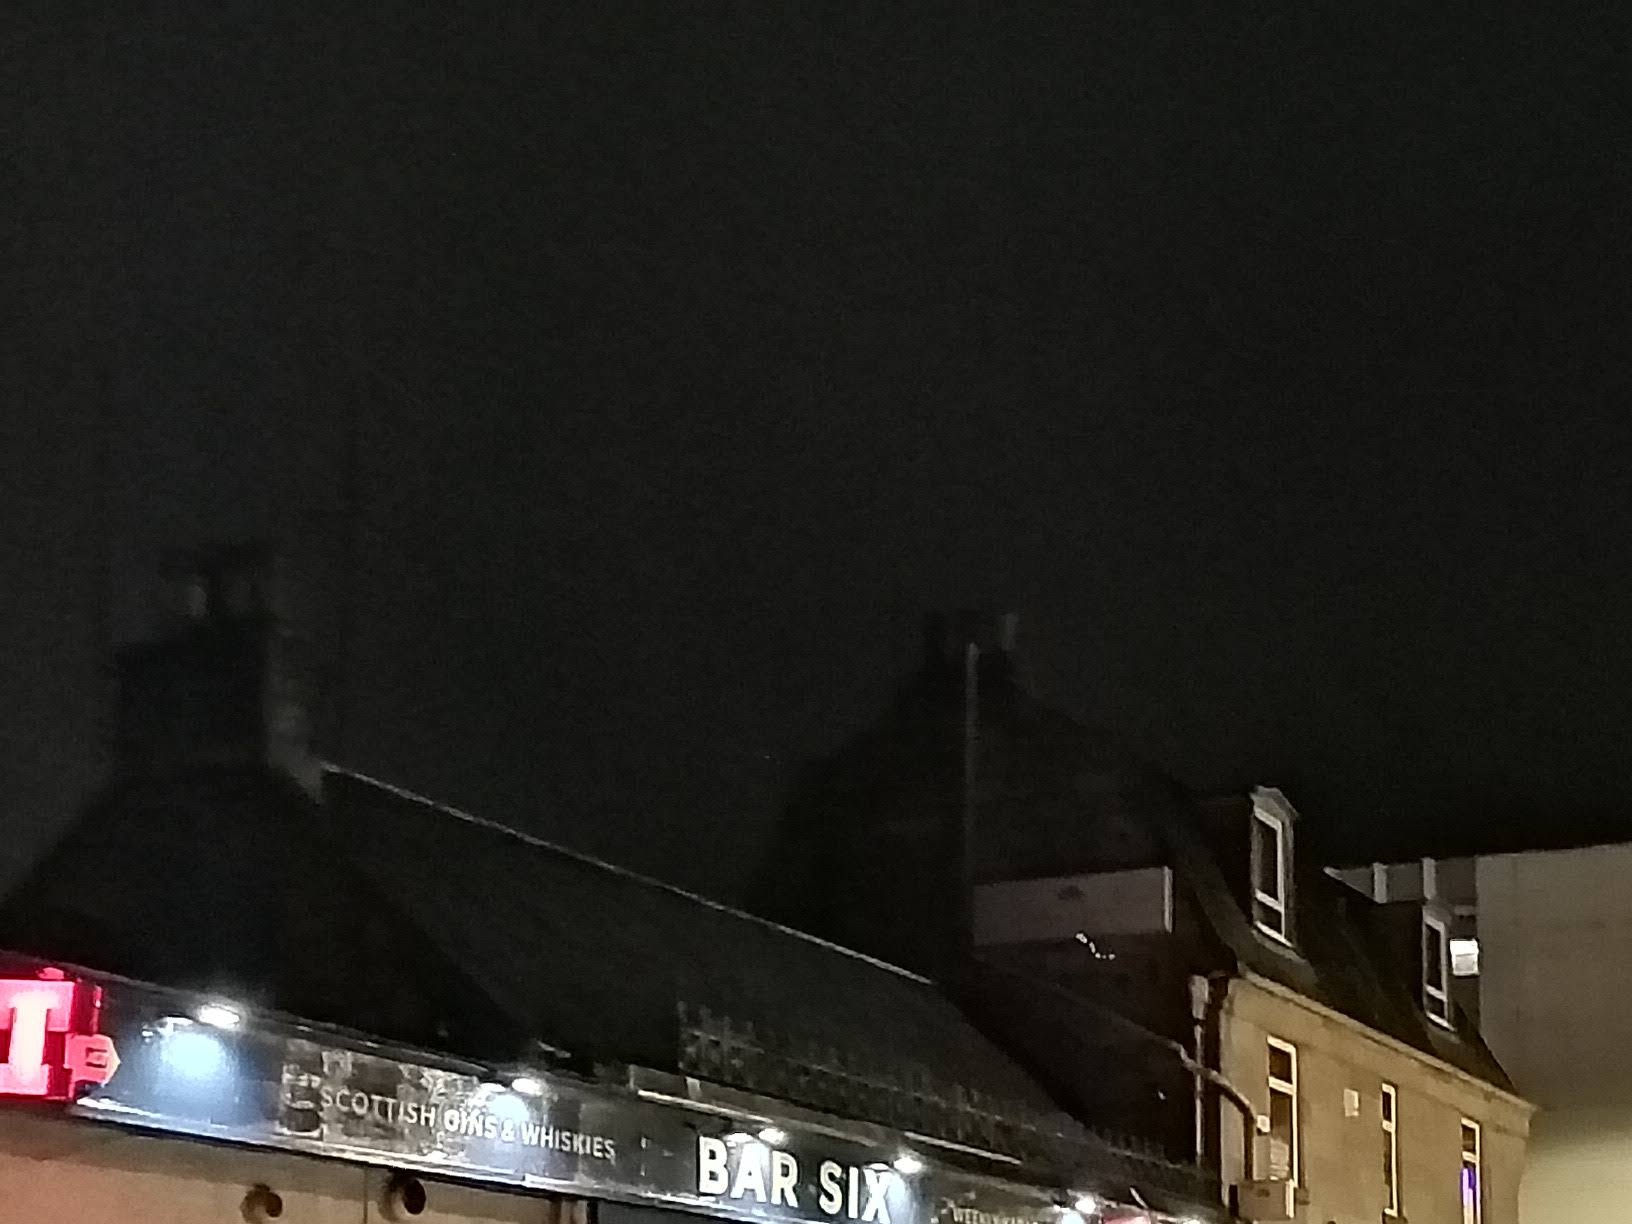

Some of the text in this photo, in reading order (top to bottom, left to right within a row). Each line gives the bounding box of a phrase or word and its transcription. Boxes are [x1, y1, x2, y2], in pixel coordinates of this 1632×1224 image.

[320, 1086, 436, 1128] SCOTTISH
[502, 1119, 515, 1141] &
[521, 1121, 616, 1159] WHISKIES
[699, 1136, 892, 1224] BAR SIX
